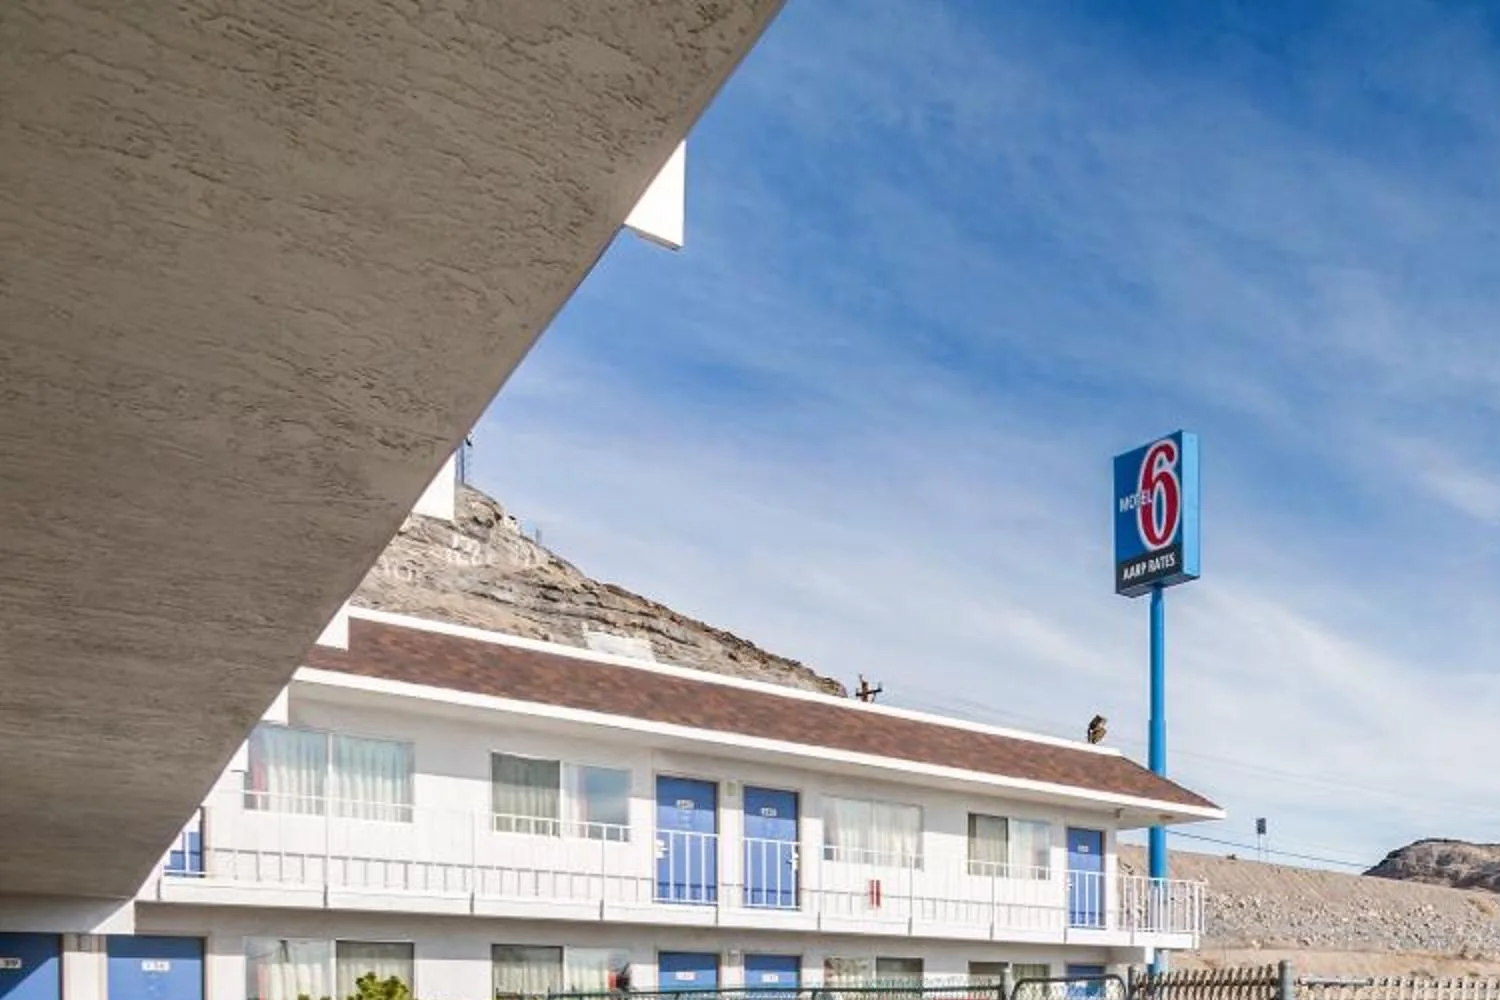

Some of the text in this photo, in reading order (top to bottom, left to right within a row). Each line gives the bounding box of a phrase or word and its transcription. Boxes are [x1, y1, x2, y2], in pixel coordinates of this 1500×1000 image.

[1120, 439, 1181, 551] MOTEL 6
[1123, 551, 1176, 580] AARP RATES
